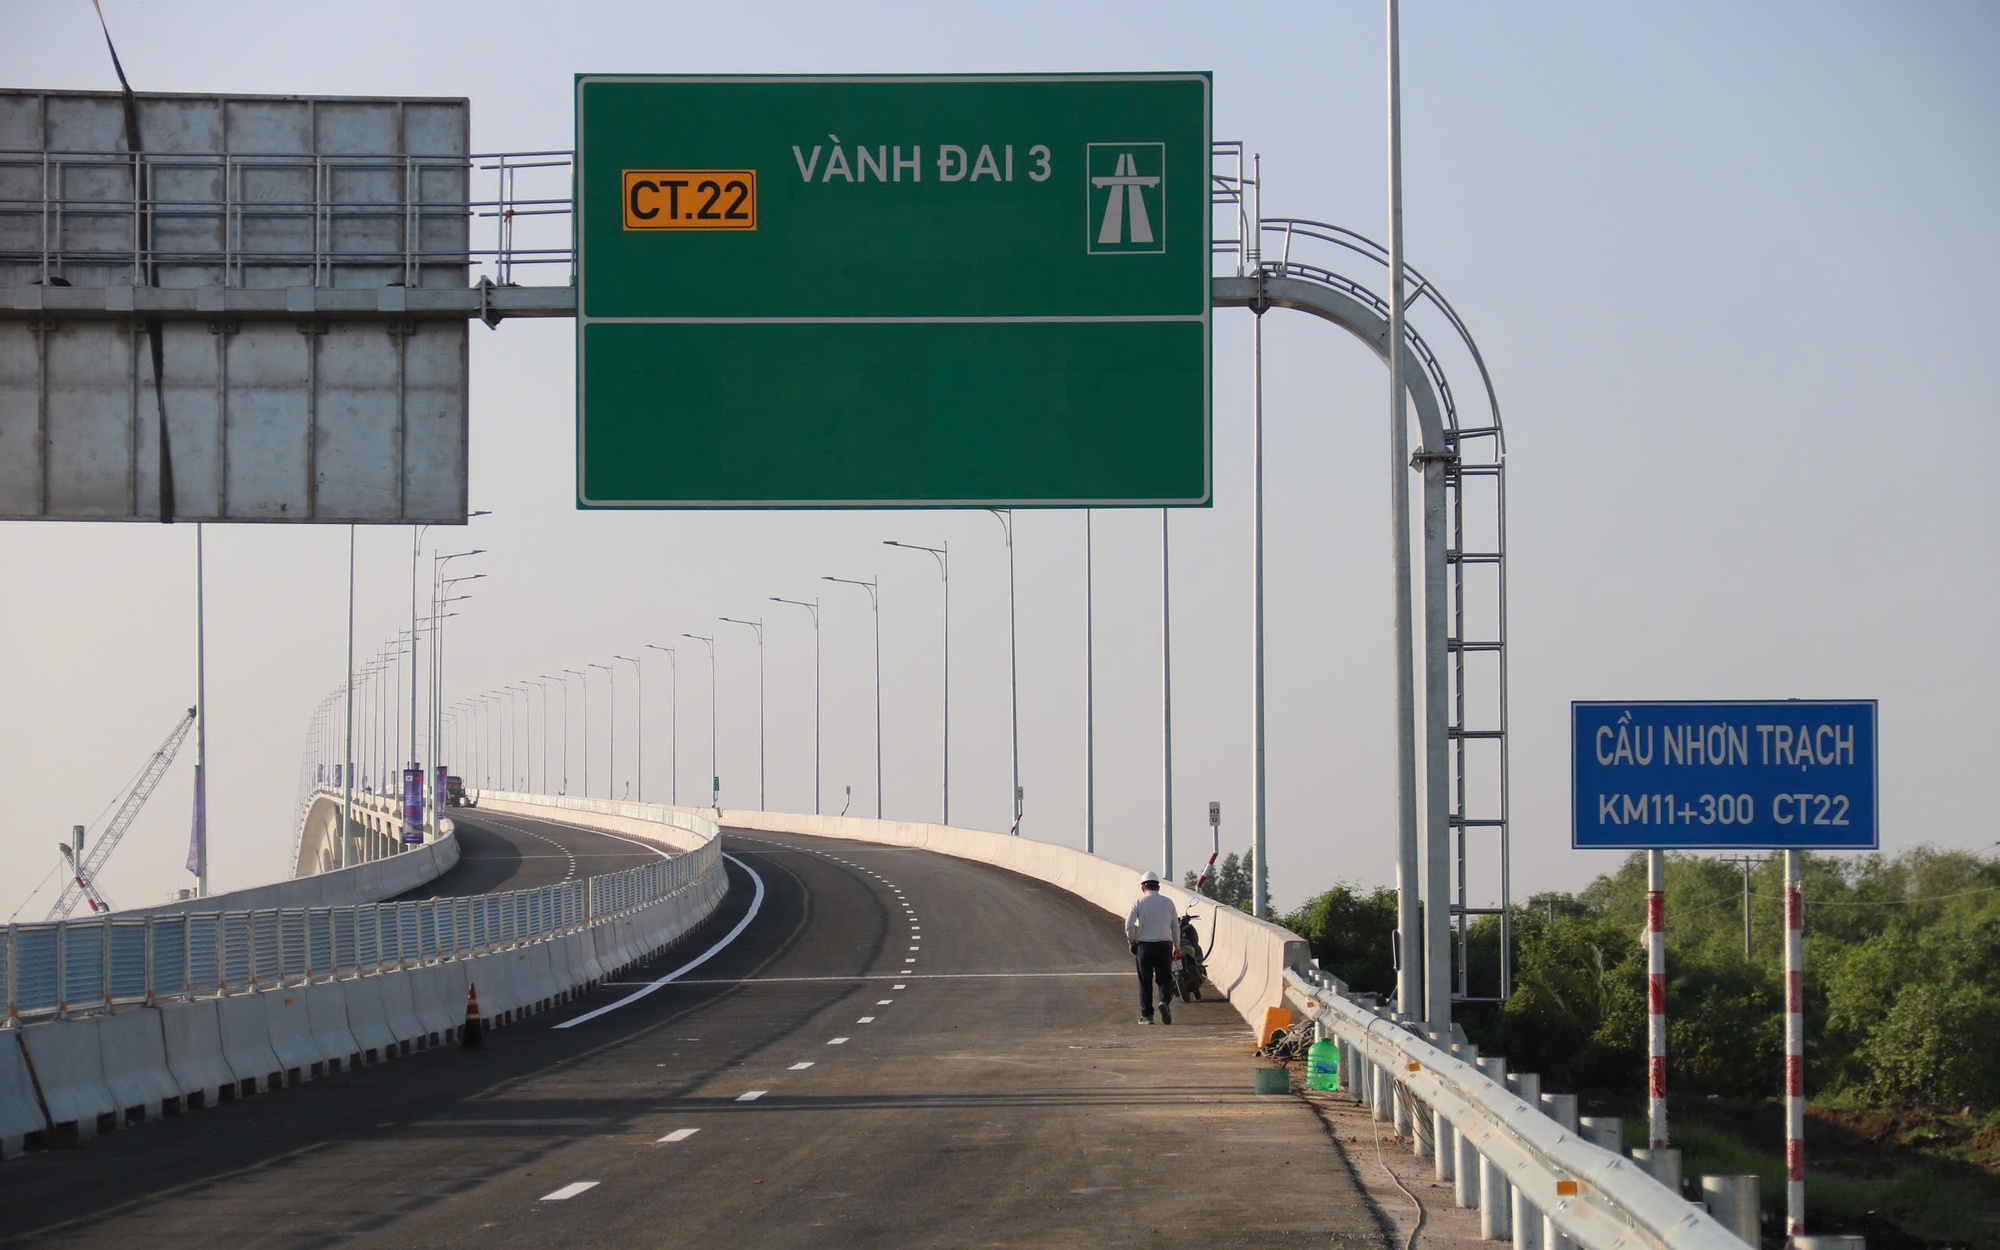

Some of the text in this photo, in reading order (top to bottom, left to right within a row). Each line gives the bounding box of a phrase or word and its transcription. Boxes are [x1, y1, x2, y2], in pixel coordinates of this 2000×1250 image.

[792, 134, 1052, 183] VÀNH ĐAI 3
[630, 179, 749, 221] CT.22
[1596, 710, 1854, 772] CẦU NHƠN TRẠCH
[1599, 793, 1850, 826] KM11+300 CT22
